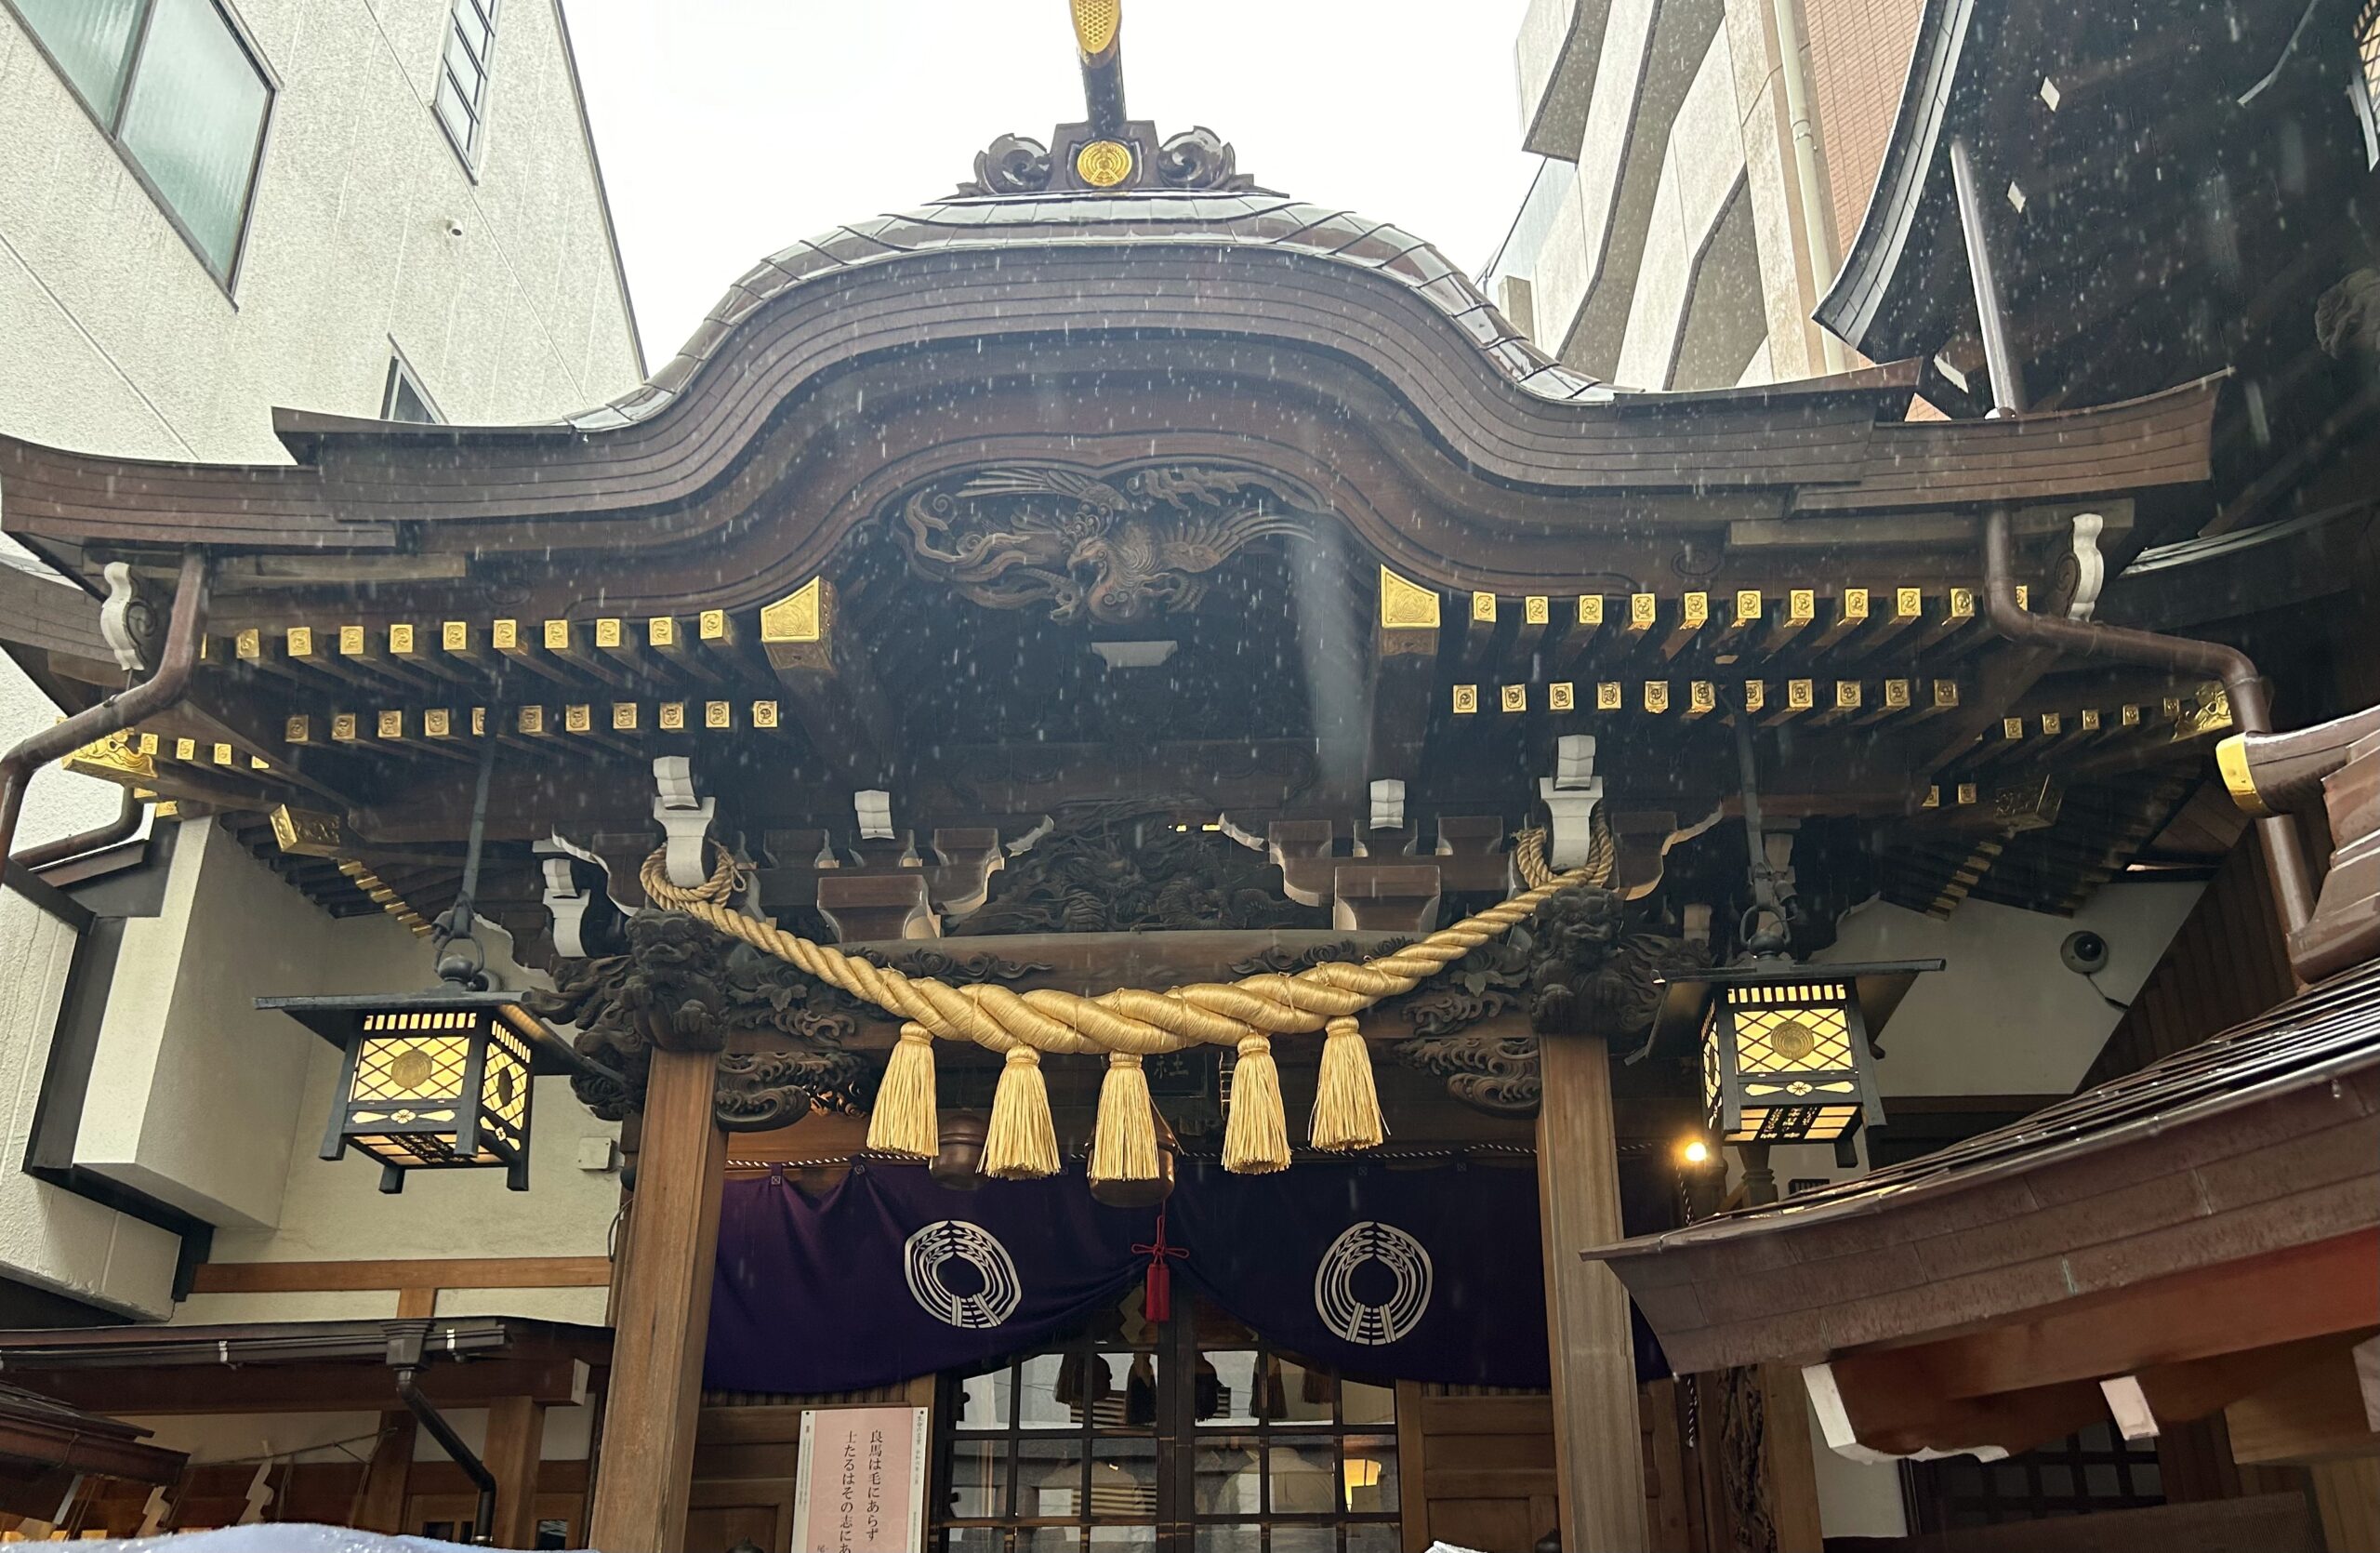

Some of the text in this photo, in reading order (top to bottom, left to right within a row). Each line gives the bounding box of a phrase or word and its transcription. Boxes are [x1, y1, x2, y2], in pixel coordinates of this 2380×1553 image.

[866, 1429, 883, 1542] 良馬は毛にあらず
